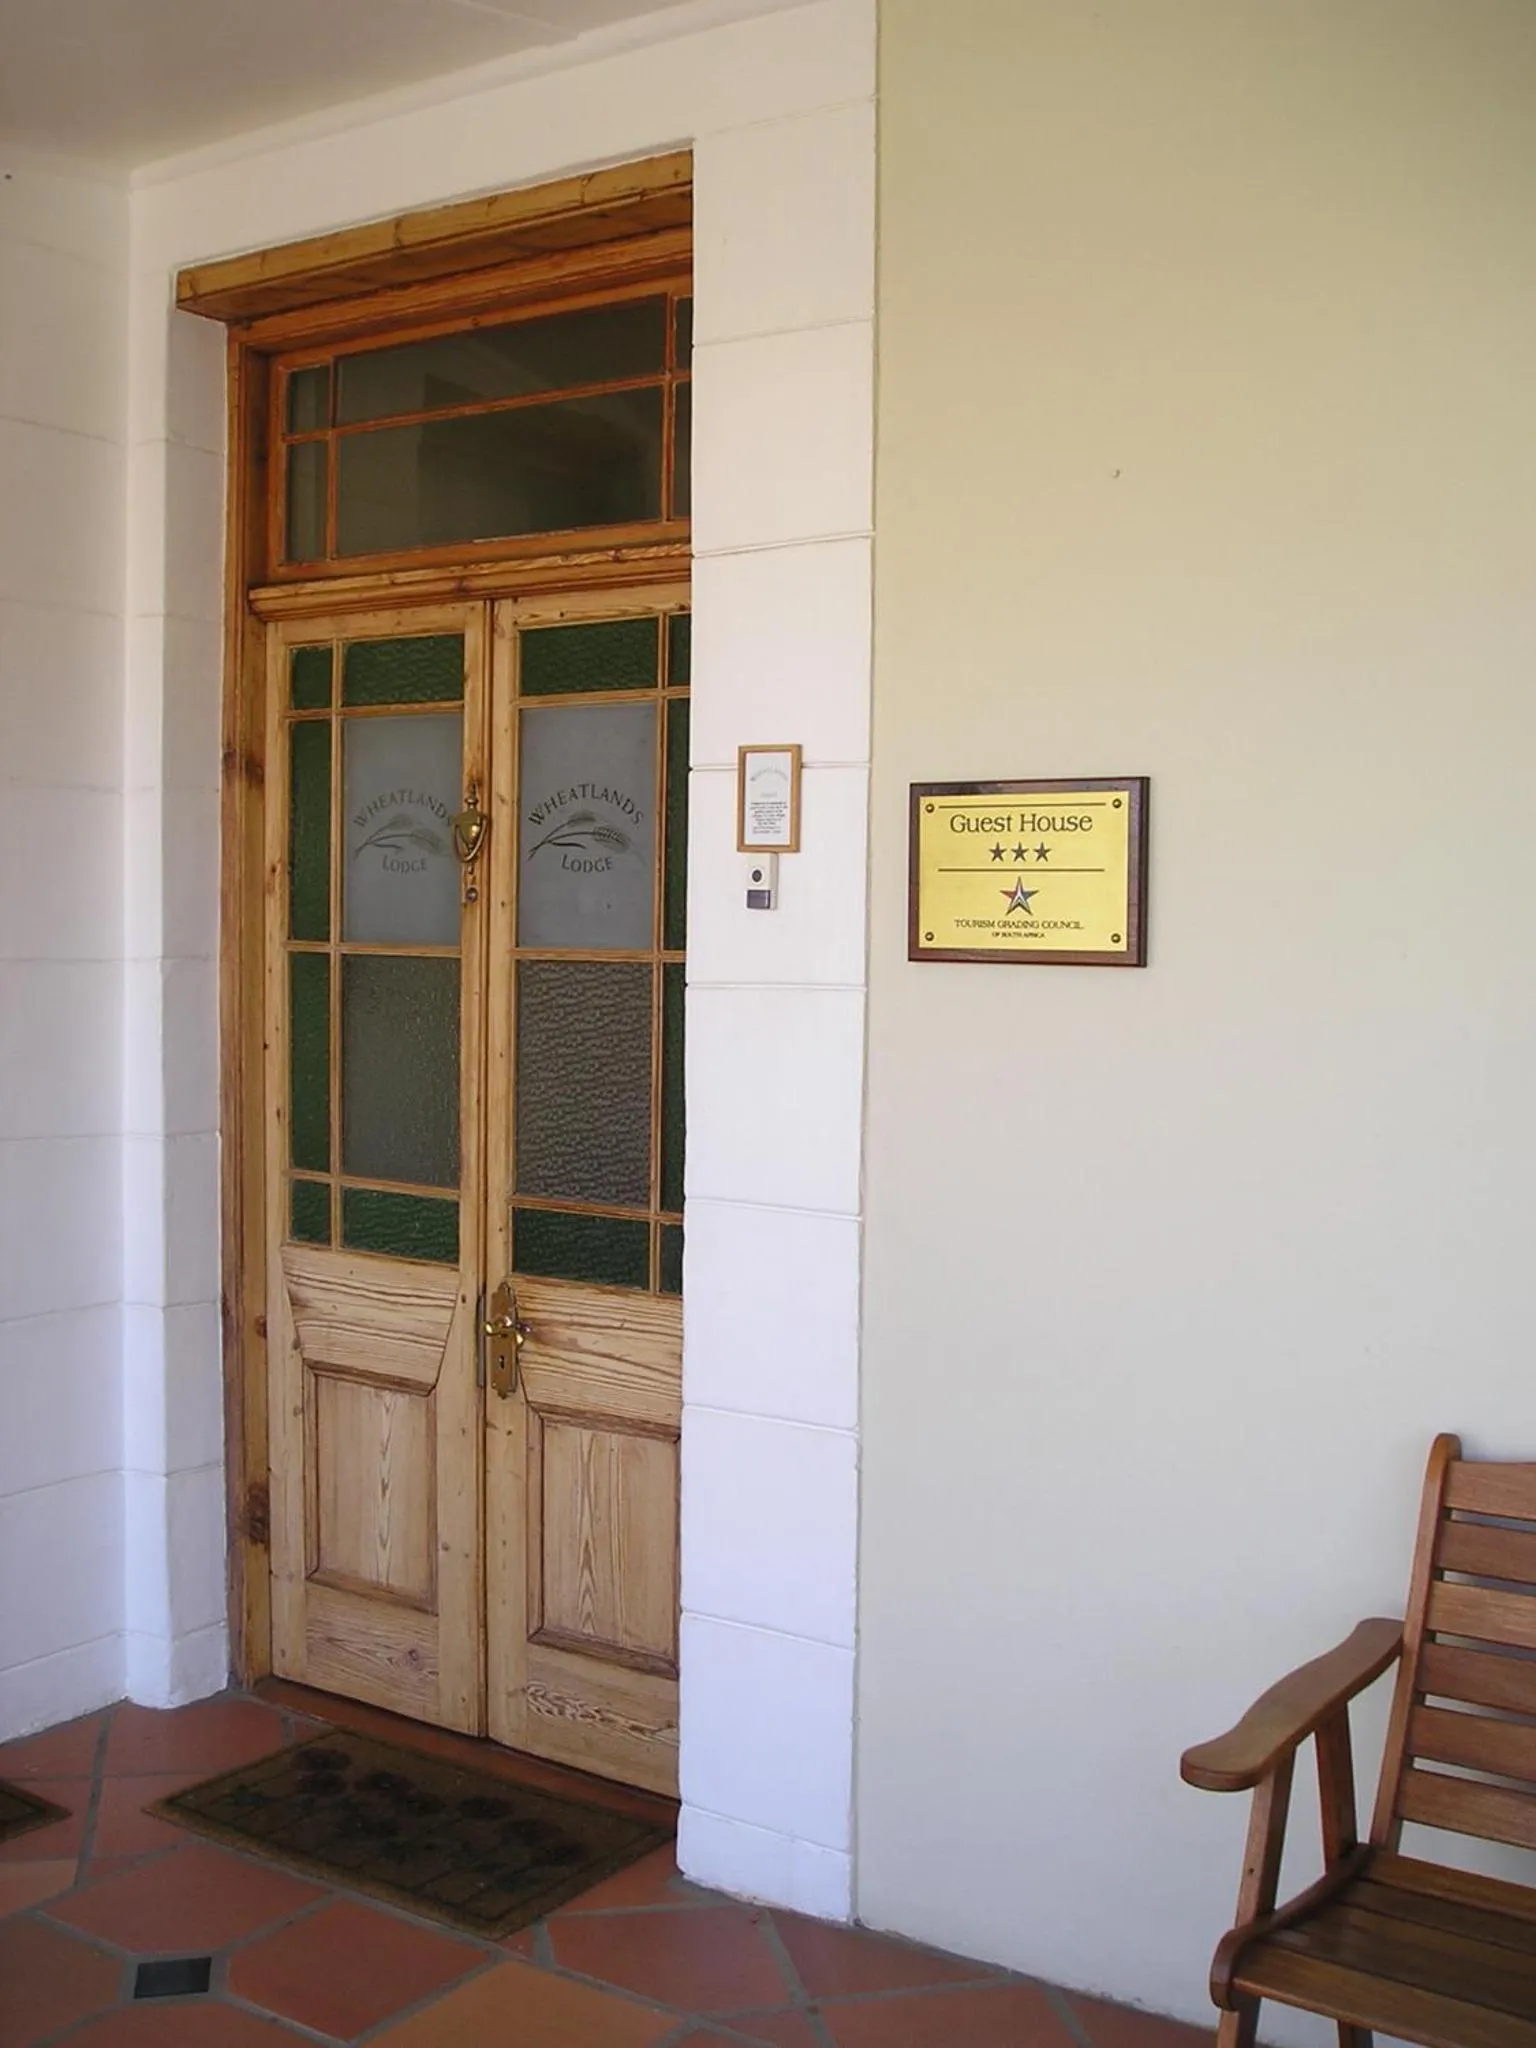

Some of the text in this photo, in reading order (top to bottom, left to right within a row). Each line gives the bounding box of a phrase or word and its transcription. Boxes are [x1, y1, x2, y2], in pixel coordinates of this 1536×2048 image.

[527, 783, 644, 826] WHEATLANDS
[950, 813, 1093, 834] Guest House
[381, 855, 428, 874] LODGE
[561, 853, 614, 873] LODGE
[954, 919, 1084, 930] TOURISM GRADING COUNCIL
